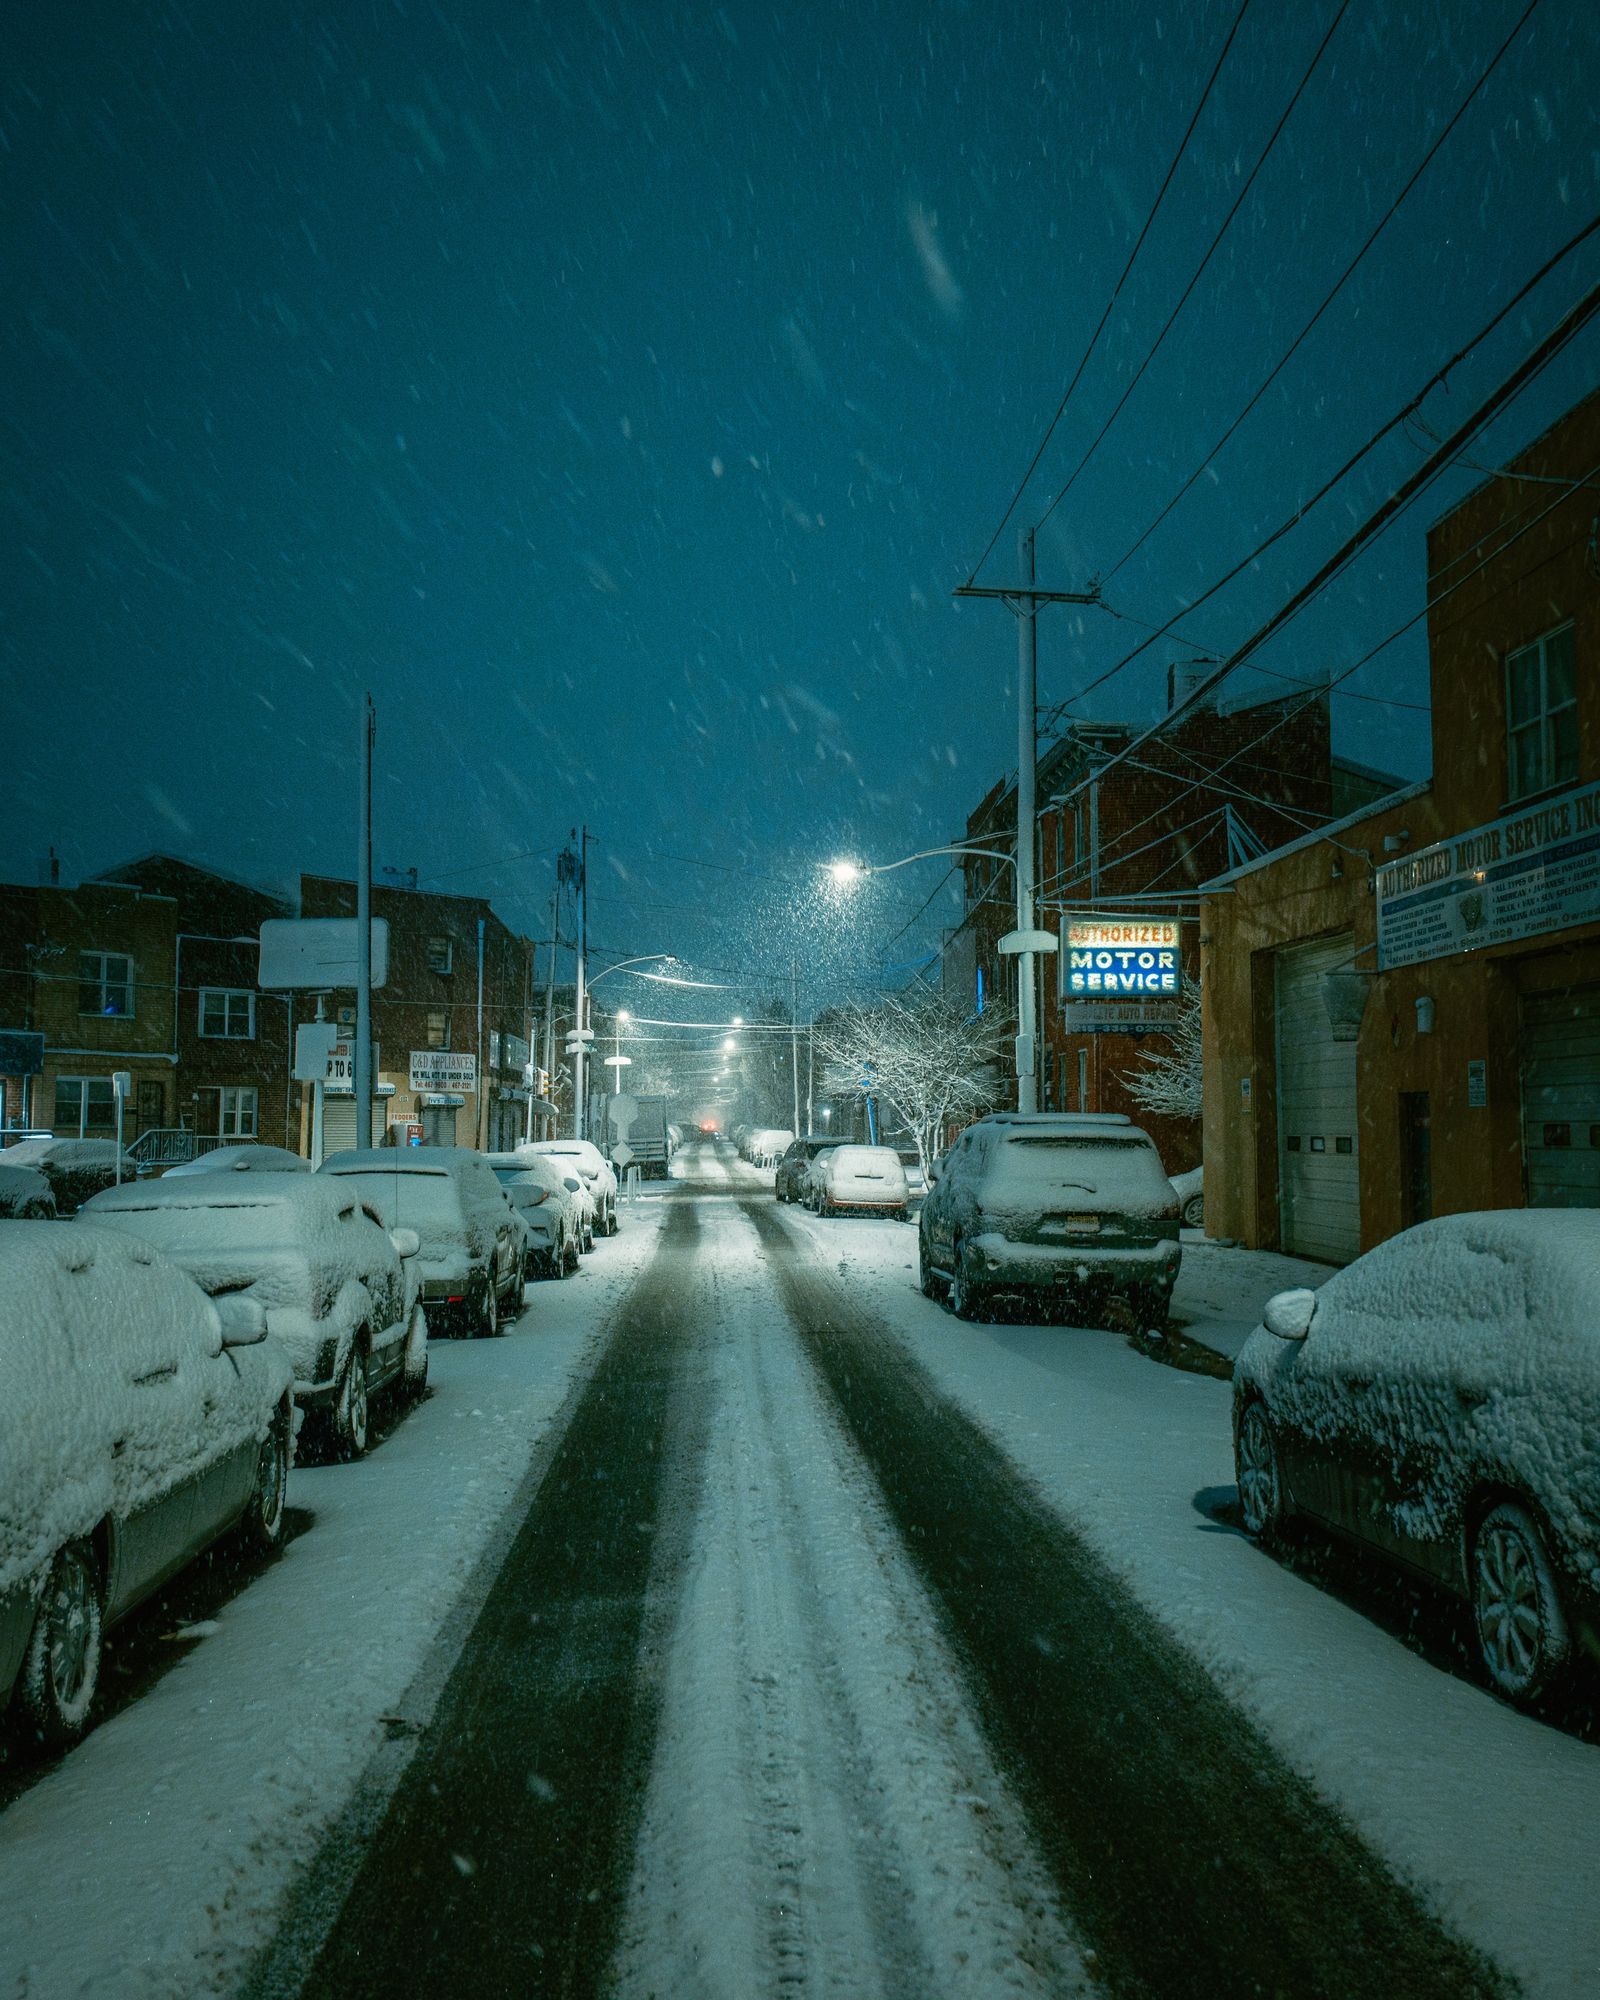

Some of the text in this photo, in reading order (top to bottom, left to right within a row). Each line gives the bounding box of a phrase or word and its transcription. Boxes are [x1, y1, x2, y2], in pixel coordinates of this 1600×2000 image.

[1381, 847, 1451, 899] AUTHORIZED
[1455, 829, 1501, 873] MOTOR
[1505, 803, 1571, 857] SERVICE
[1496, 889, 1526, 903] AMERICAN
[1557, 880, 1598, 897] SPECIALISTS
[1070, 926, 1174, 943] AUTHORIZED
[1393, 954, 1414, 965] Motor
[1417, 942, 1457, 959] Specialist
[1460, 935, 1485, 947] Since
[1525, 917, 1559, 932] Family
[1071, 951, 1174, 969] MOTOR
[1071, 972, 1175, 990] SERVICE
[1119, 1007, 1139, 1020] AUTO
[335, 1060, 345, 1078] TO
[412, 1055, 474, 1070] C&D APPLIANCES
[412, 1071, 419, 1079] WE
[420, 1071, 430, 1079] WILL
[432, 1071, 440, 1079] NOT
[448, 1072, 461, 1080] UNDER
[463, 1072, 473, 1080] SOLD
